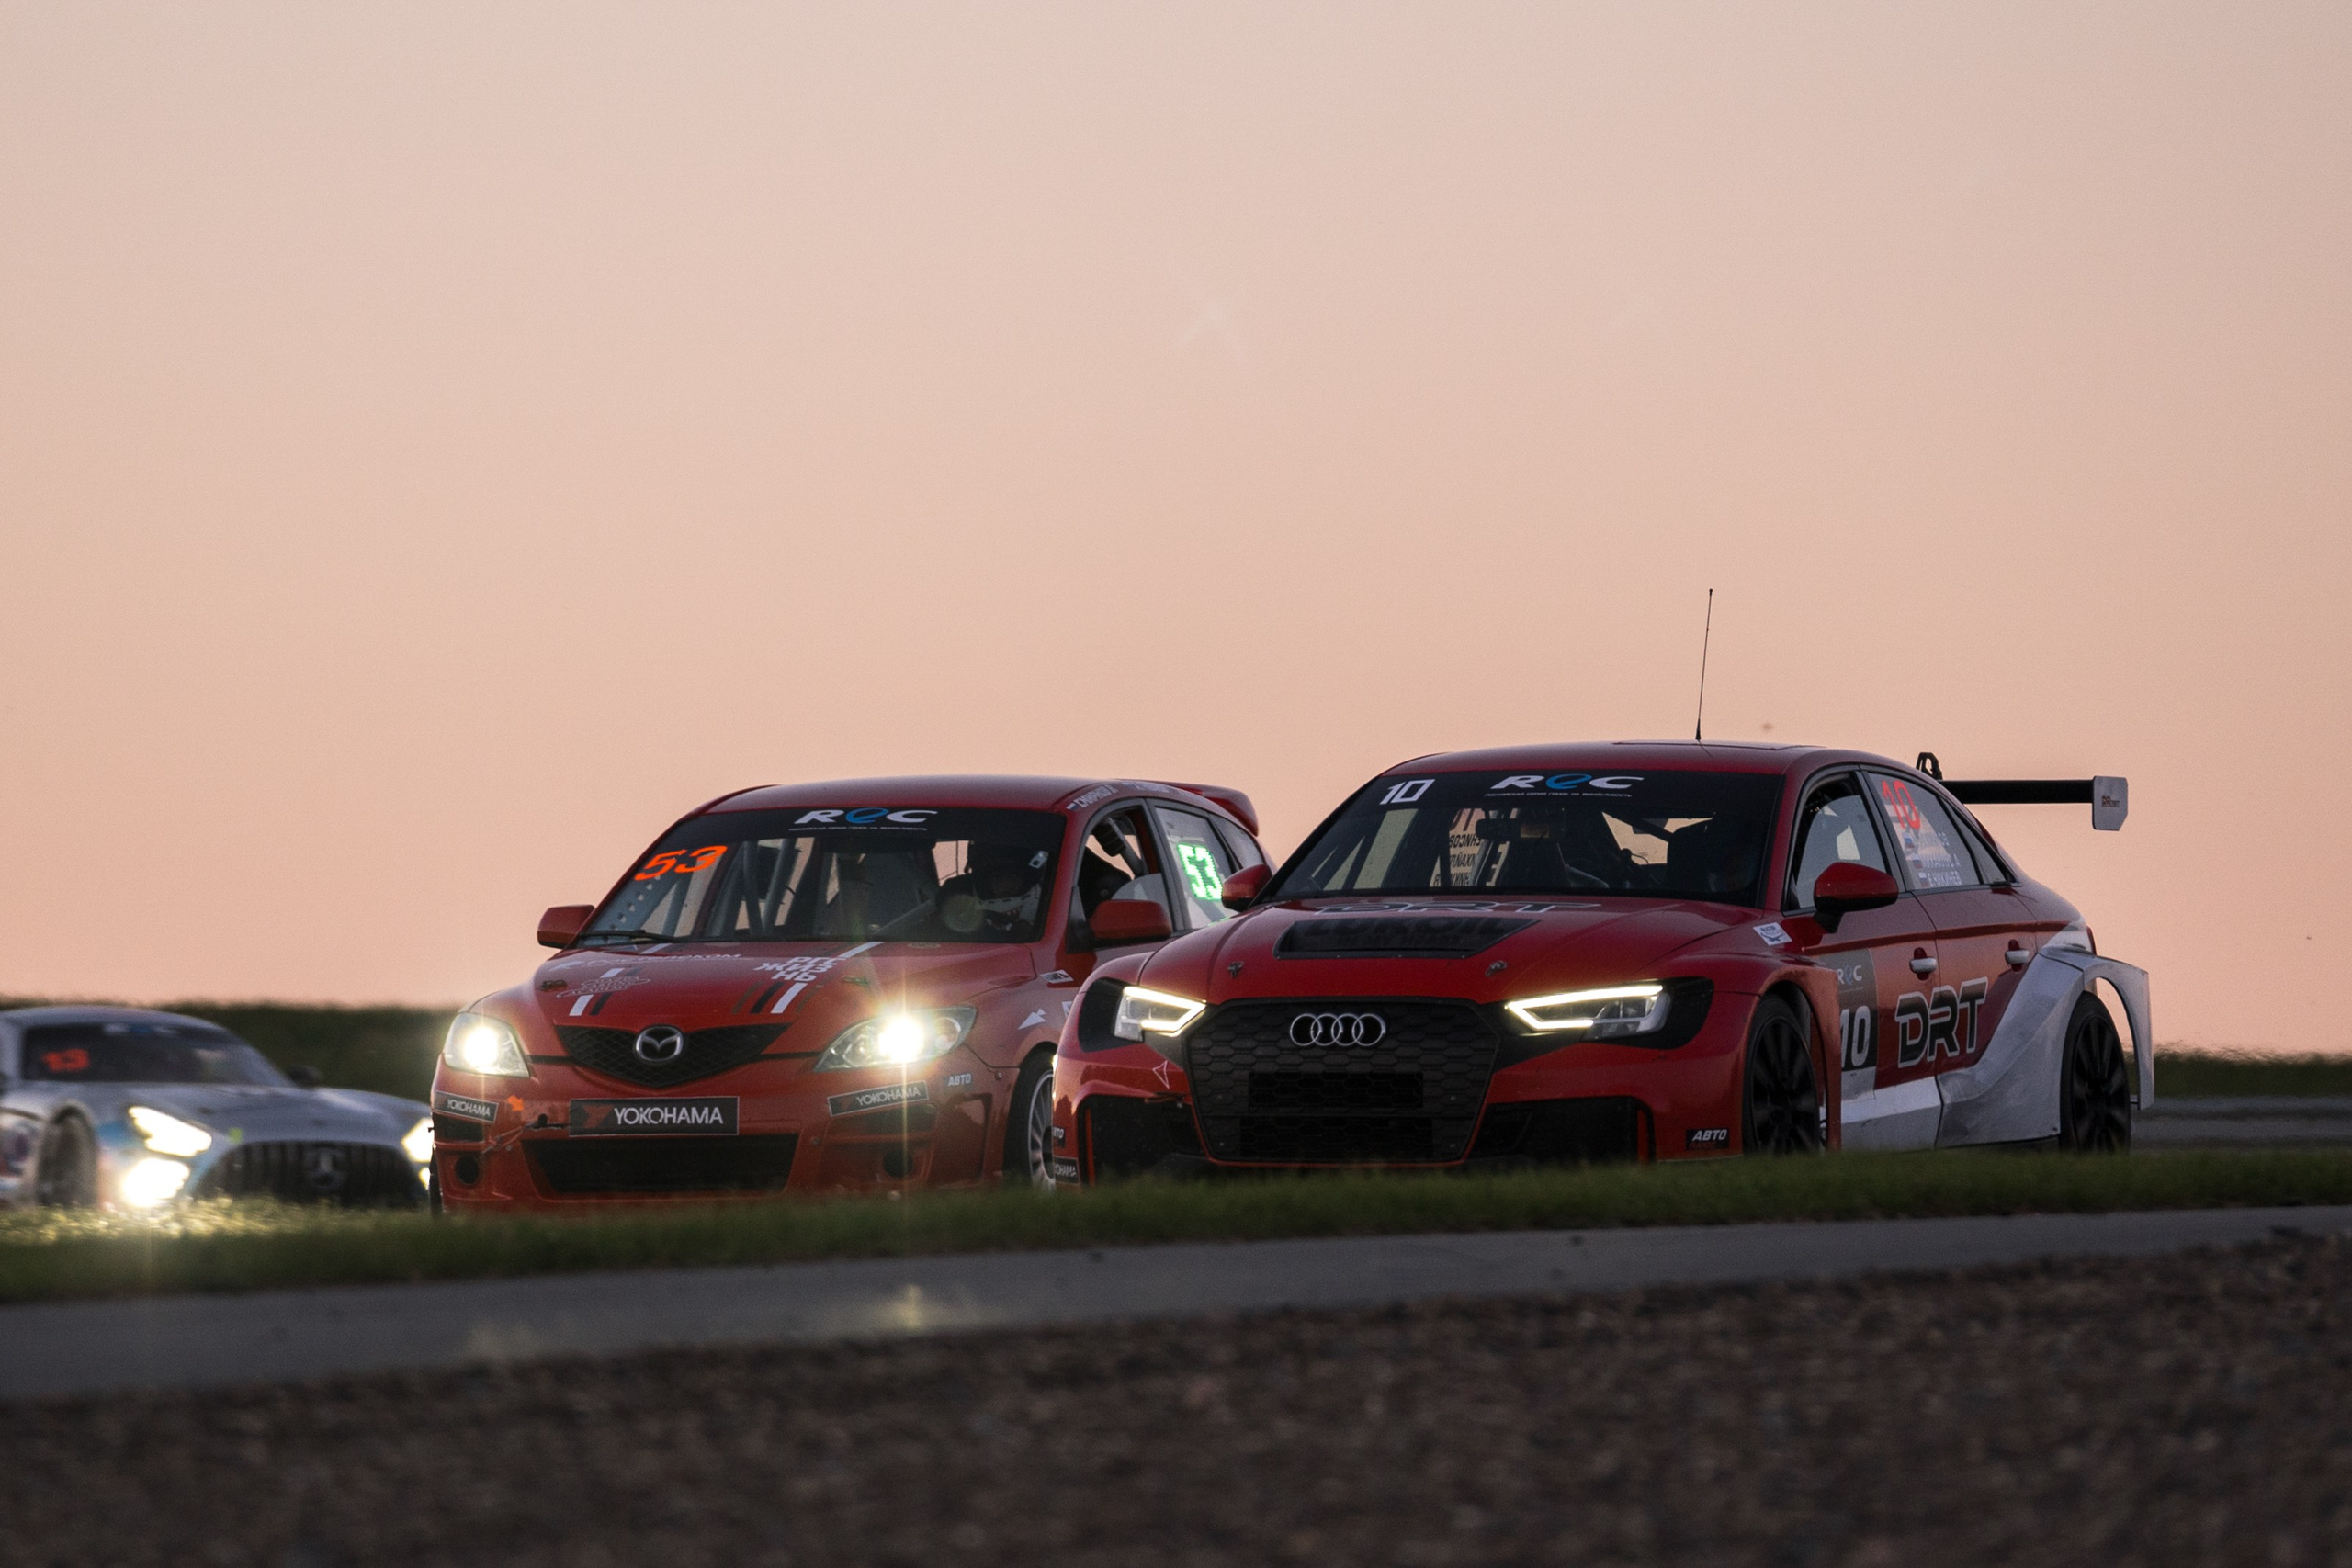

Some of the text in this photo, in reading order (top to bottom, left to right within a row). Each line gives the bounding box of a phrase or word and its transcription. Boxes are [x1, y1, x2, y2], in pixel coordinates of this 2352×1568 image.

[1379, 778, 1435, 805] 10
[1882, 779, 1921, 829] 10
[634, 845, 728, 881] 53
[1177, 843, 1223, 901] 53
[1315, 900, 1602, 914] DRT
[753, 963, 833, 972] ЖИЗ
[1894, 977, 1989, 1068] DRT
[1840, 1005, 1871, 1067] 10
[947, 1073, 972, 1087] АВТО
[856, 1086, 921, 1106] YOKOHAMA
[447, 1099, 491, 1117] YOKOHAMA
[614, 1106, 724, 1125] YOKOHAMA
[1053, 1126, 1065, 1139] ВТО
[1691, 1128, 1728, 1142] АВТО
